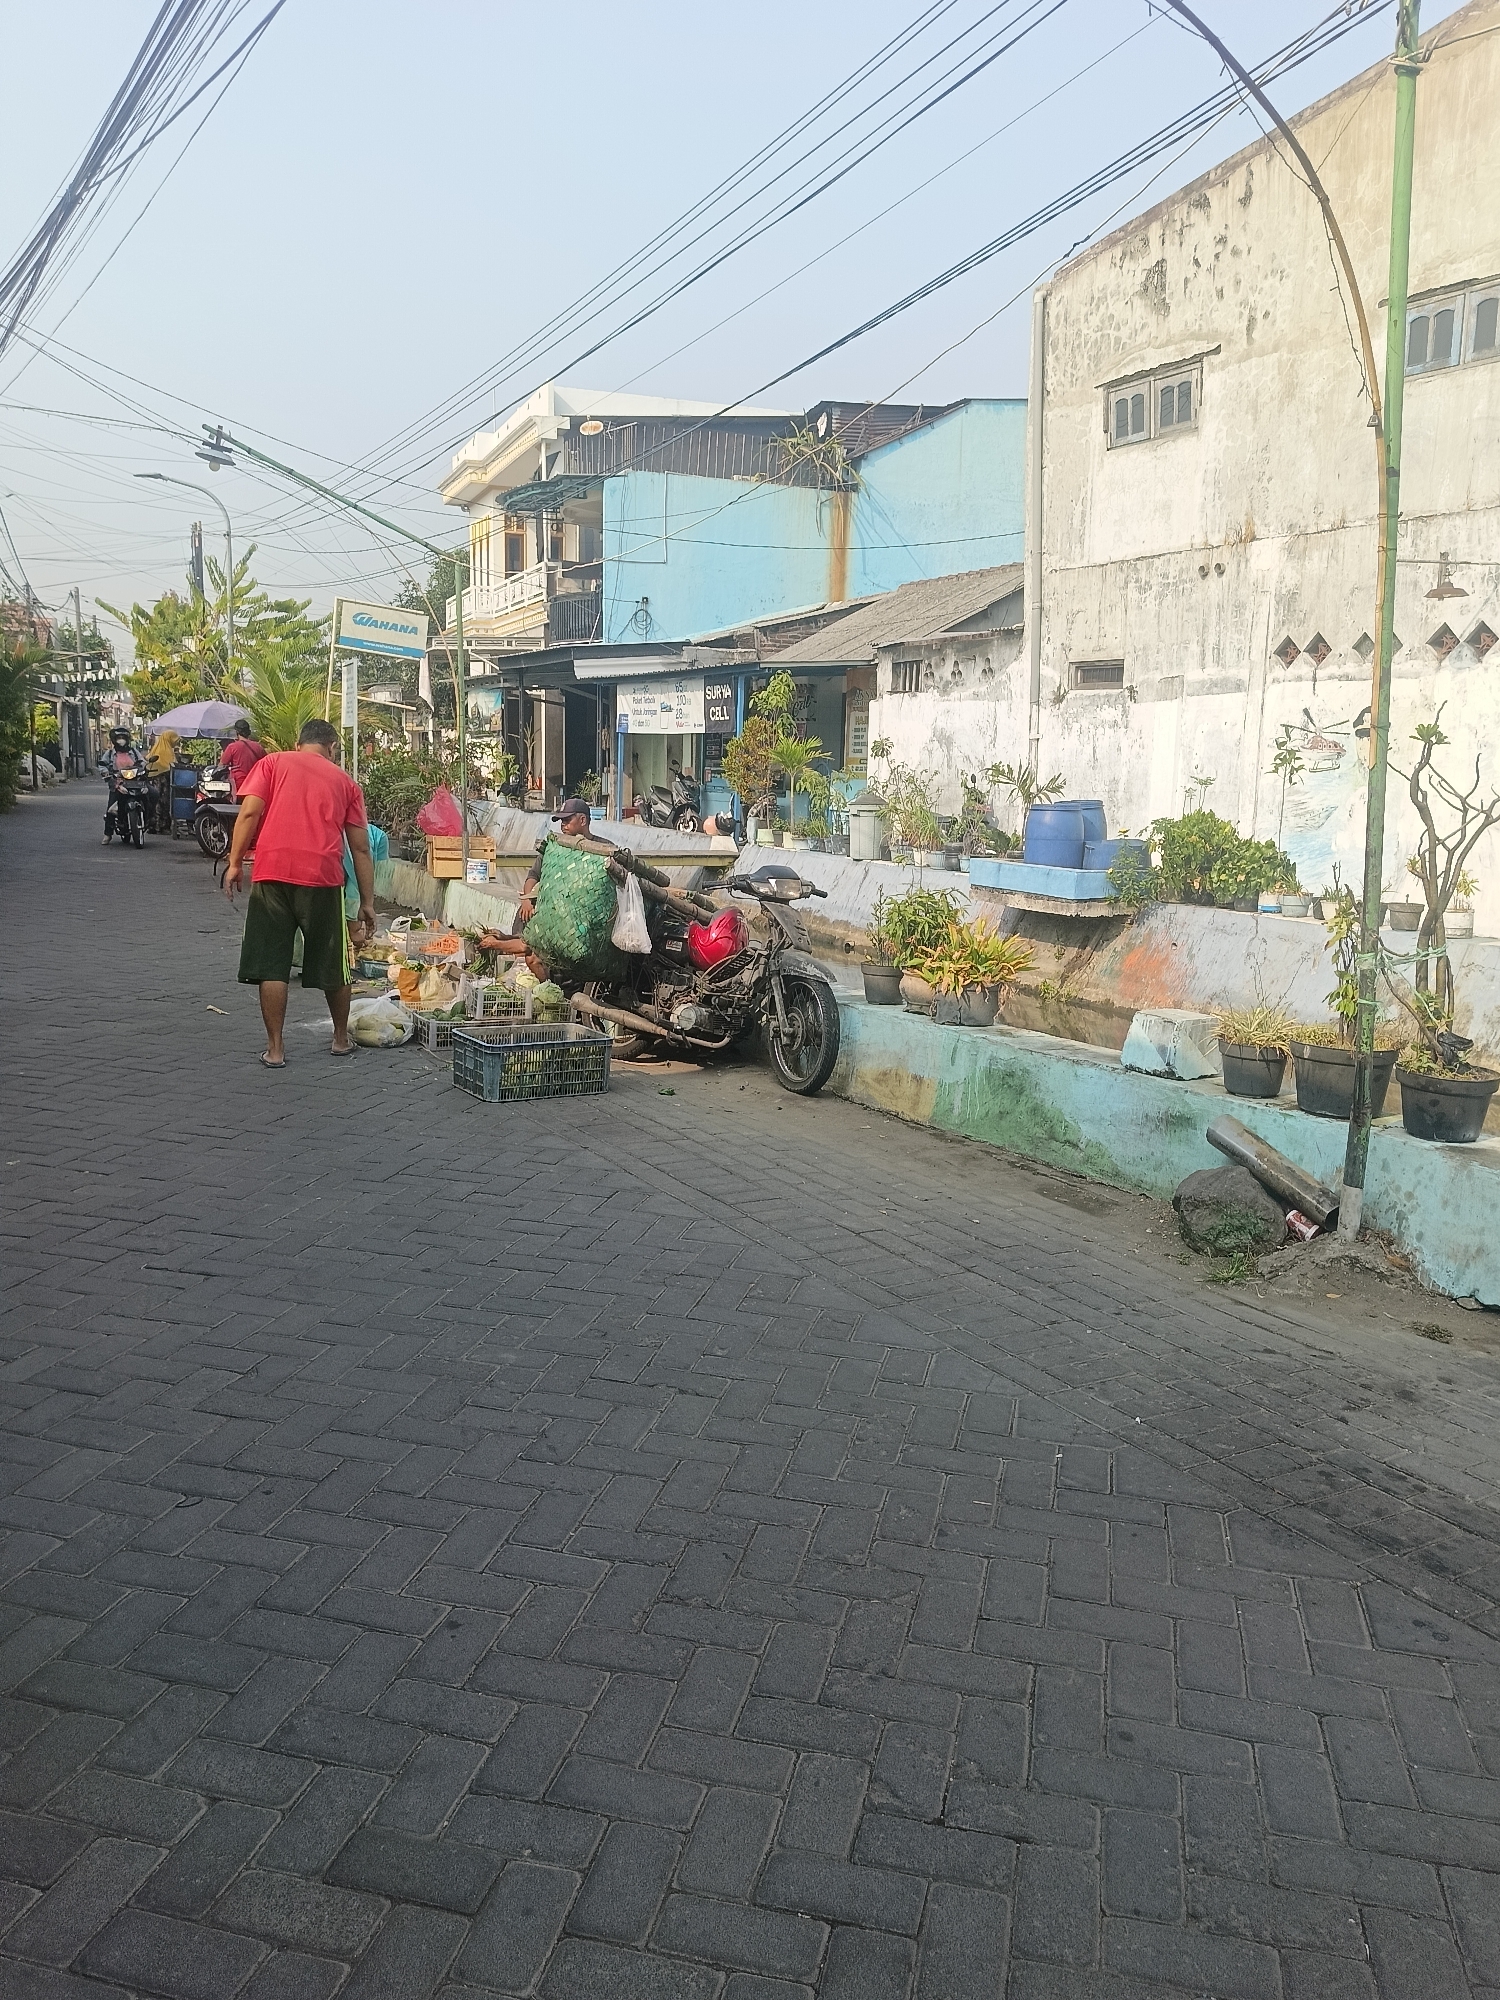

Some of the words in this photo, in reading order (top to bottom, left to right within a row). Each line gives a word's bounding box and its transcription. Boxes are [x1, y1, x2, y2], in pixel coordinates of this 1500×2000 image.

[352, 612, 418, 635] WAHANA
[705, 683, 732, 700] SURYA
[709, 705, 730, 721] CELL
